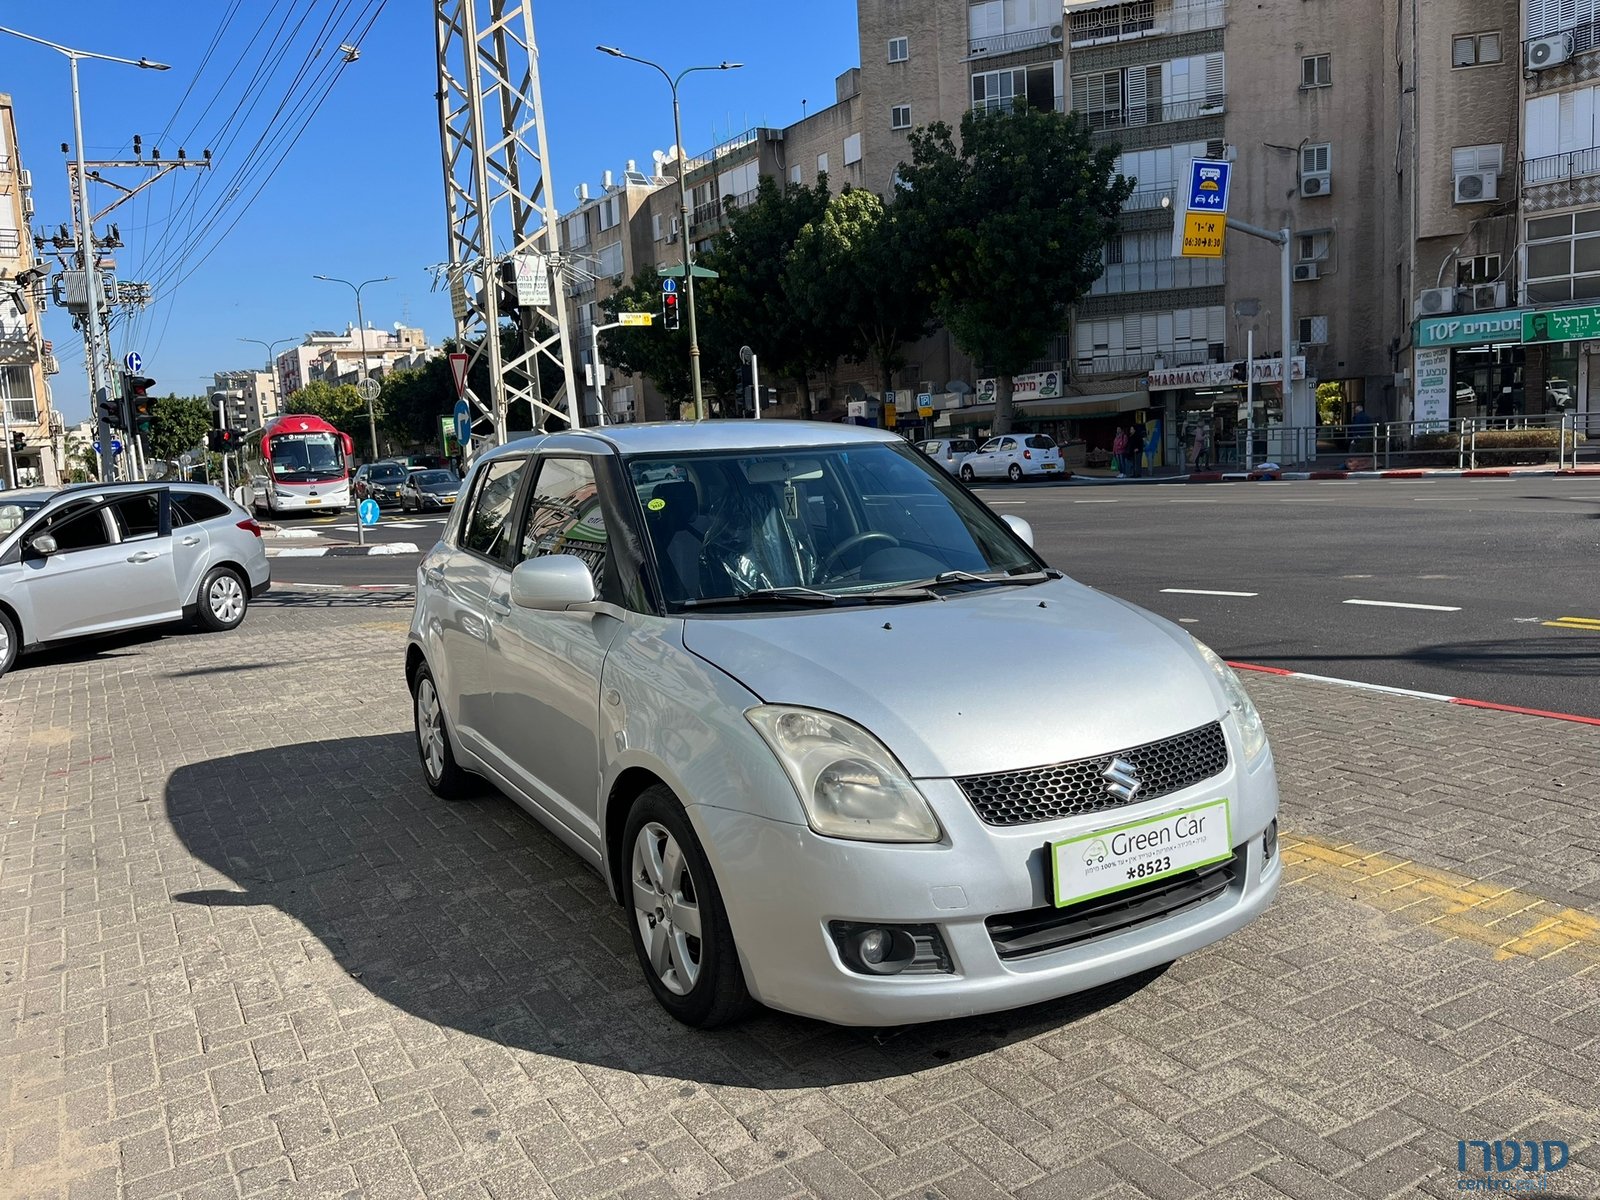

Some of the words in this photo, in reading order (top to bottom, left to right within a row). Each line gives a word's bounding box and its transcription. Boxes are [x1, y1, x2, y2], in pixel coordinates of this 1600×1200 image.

[1208, 194, 1219, 204] 4+
[1426, 321, 1460, 340] TOP
[1149, 370, 1206, 386] PHARMACY
[1111, 826, 1171, 856] Green
[1175, 816, 1206, 839] Car
[1101, 862, 1117, 870] 100%
